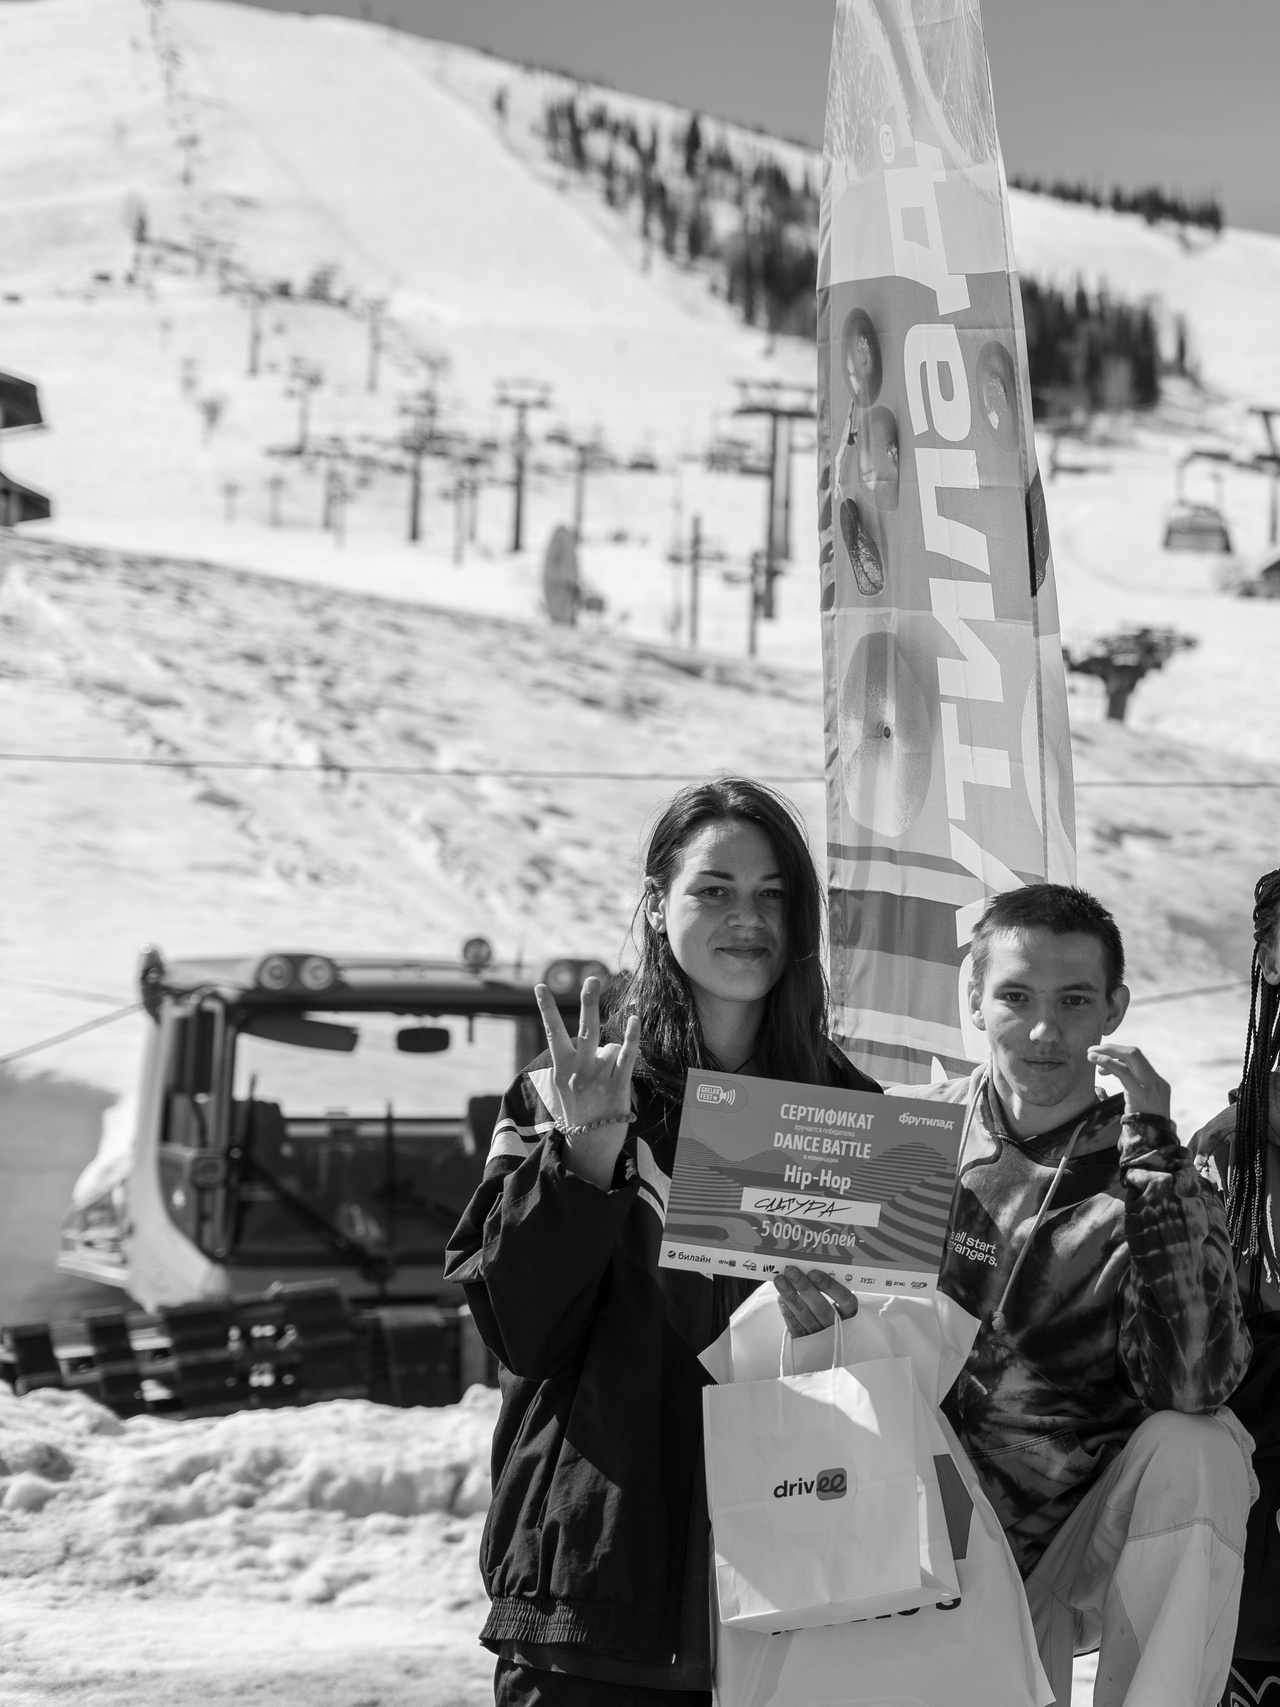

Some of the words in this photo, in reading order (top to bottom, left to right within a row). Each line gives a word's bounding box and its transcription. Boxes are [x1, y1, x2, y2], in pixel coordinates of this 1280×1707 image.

[780, 1103, 875, 1129] СЕРТИФИКАТ
[899, 1112, 955, 1130] фрутилад
[794, 1124, 823, 1134] вручается
[823, 1127, 856, 1138] победителю
[773, 1132, 821, 1153] DANCE
[822, 1137, 872, 1159] BATTLE
[807, 1155, 839, 1164] номинации
[784, 1164, 852, 1195] Hip-Hop
[803, 1228, 856, 1249] рублей
[966, 1237, 996, 1254] start
[678, 1251, 711, 1263] билайн
[773, 1471, 848, 1499] drivee
